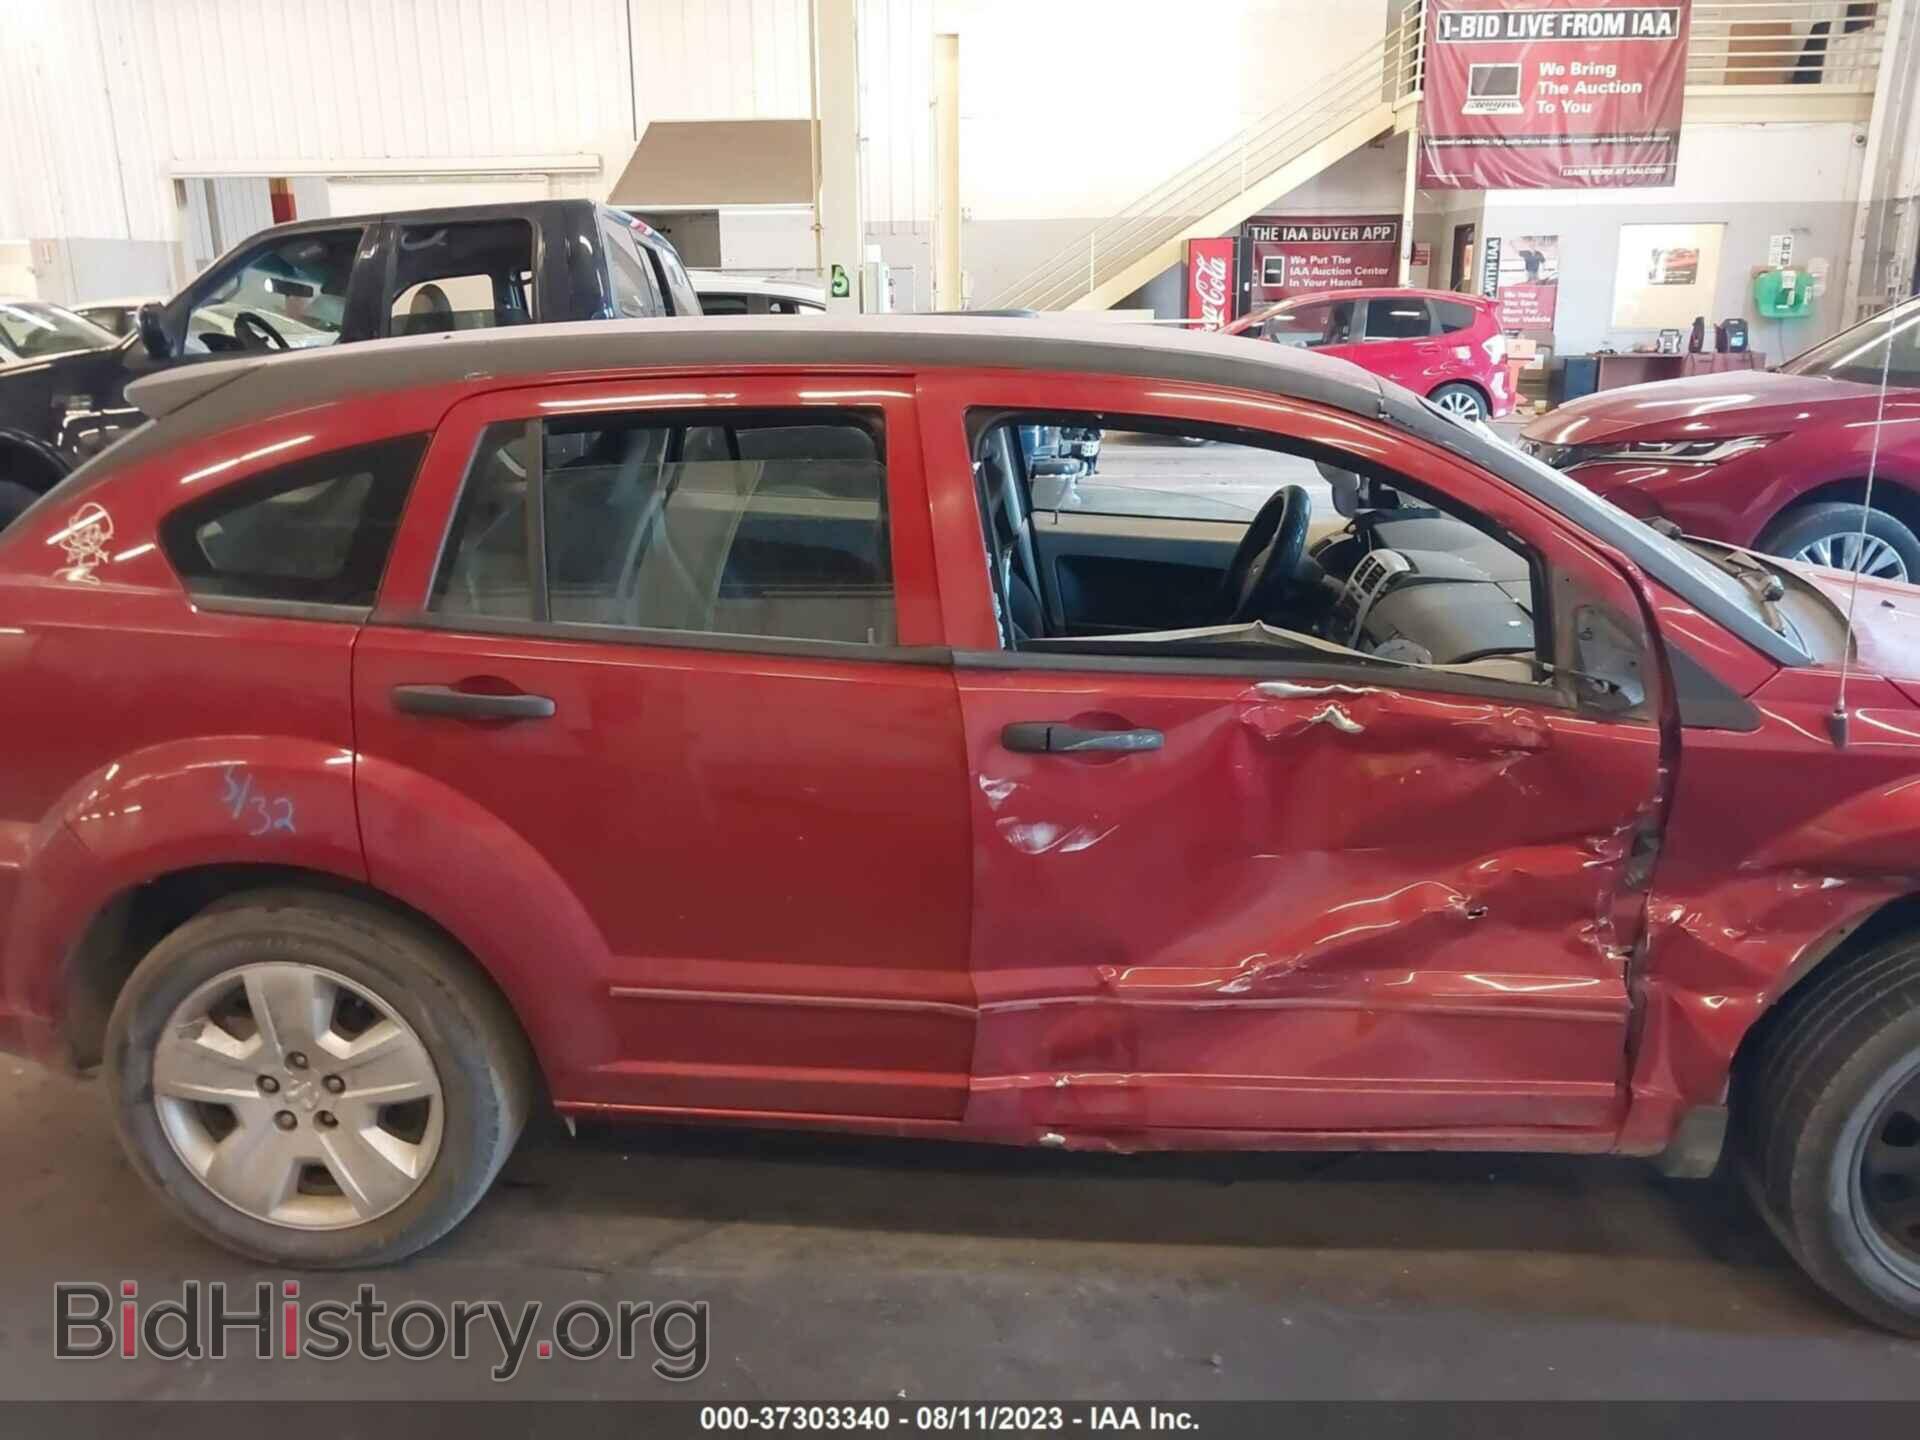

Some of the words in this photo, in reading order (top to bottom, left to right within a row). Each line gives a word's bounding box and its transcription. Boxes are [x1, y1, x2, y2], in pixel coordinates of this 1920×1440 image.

[1443, 15, 1500, 38] I-BID
[1507, 13, 1558, 37] LIVE
[1561, 12, 1626, 36] FROM
[1632, 12, 1672, 35] IAA
[1539, 62, 1565, 76] We
[1570, 61, 1617, 78] Bring
[1538, 81, 1569, 95] The
[1574, 80, 1642, 94] Auction
[1536, 100, 1556, 113] To
[1560, 100, 1592, 113] You
[1252, 227, 1279, 240] THE
[1282, 227, 1309, 241] IAA
[1311, 226, 1360, 241] BUYER
[1361, 226, 1391, 240] APP
[1290, 255, 1307, 265] We
[1310, 255, 1329, 265] Put
[1331, 255, 1352, 265] The
[1289, 266, 1310, 276] IAA
[1312, 266, 1352, 275] Auction
[1354, 266, 1389, 275] Center
[833, 264, 849, 297] 5
[1289, 278, 1300, 287] In
[1302, 278, 1328, 287] Your
[1329, 278, 1363, 287] Hands
